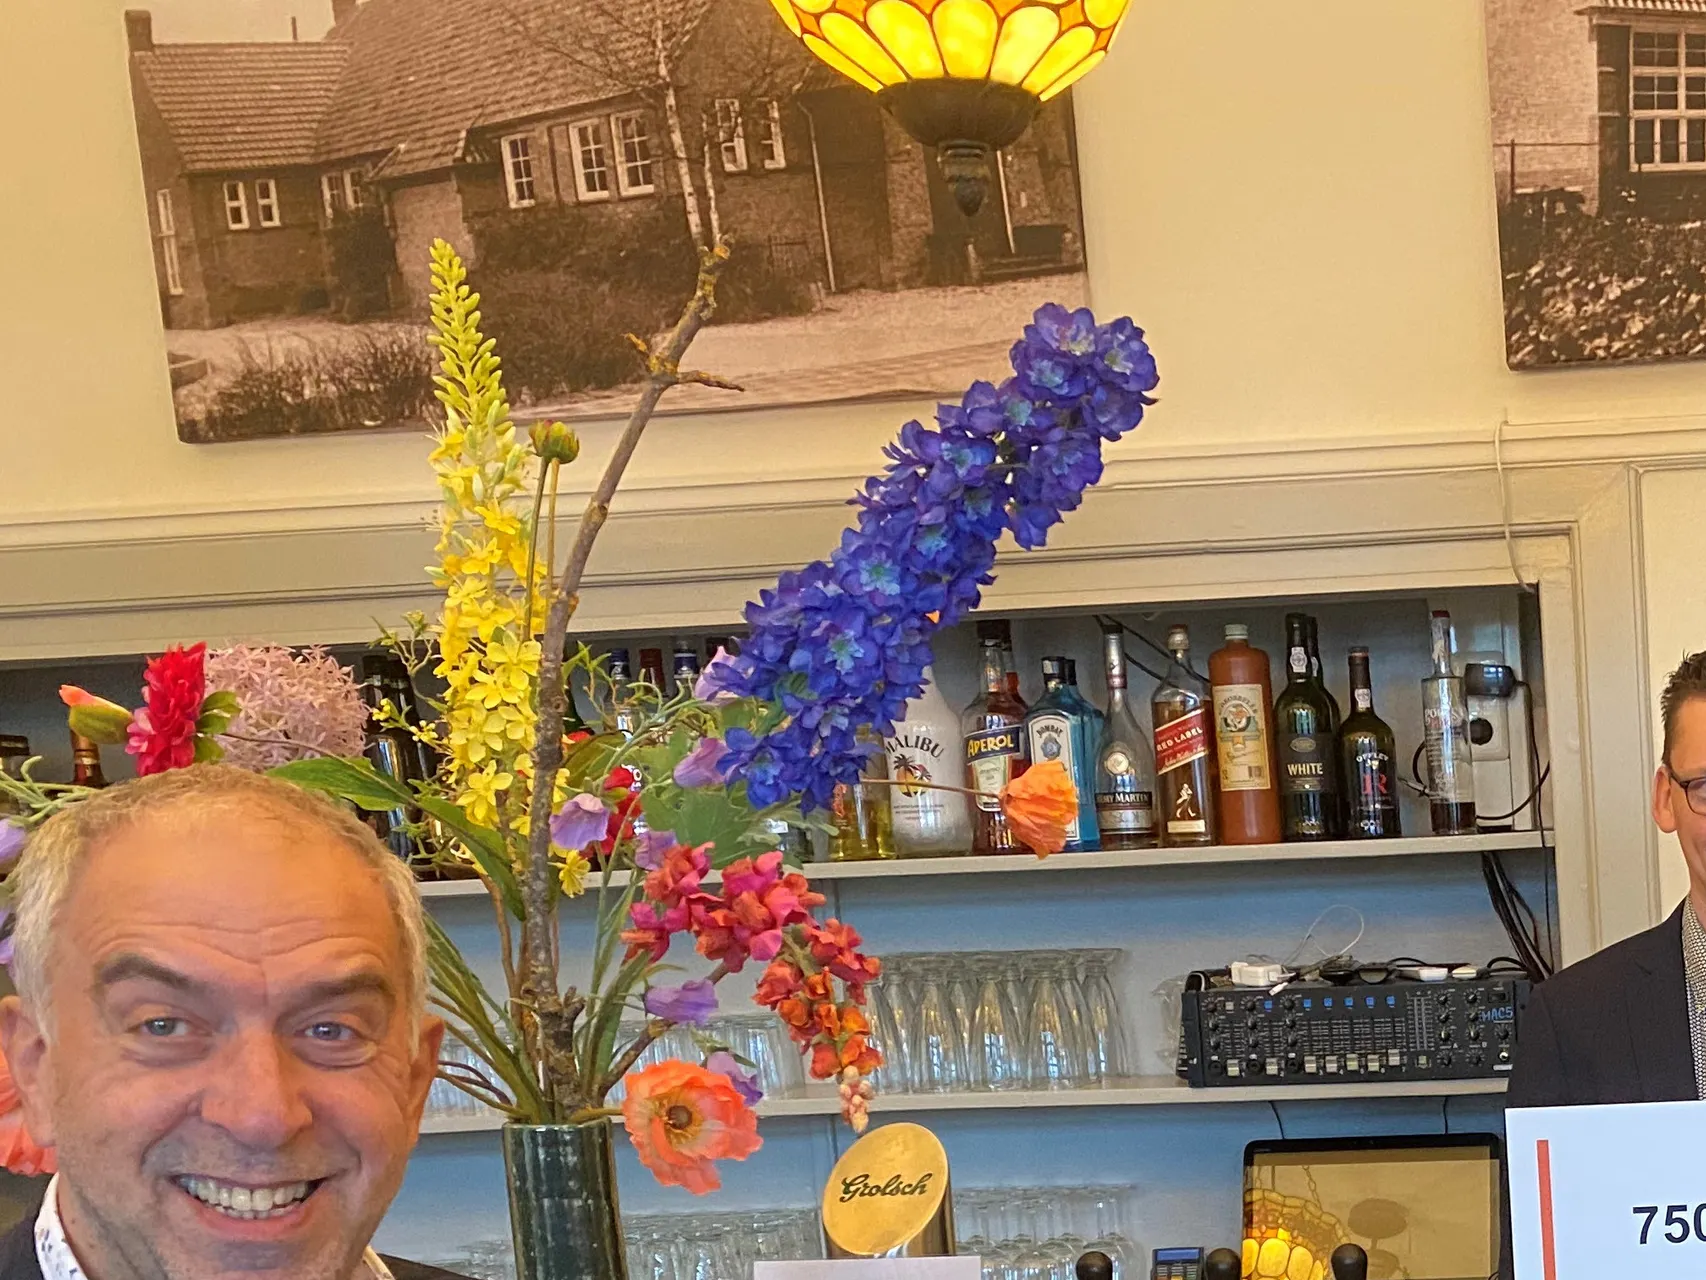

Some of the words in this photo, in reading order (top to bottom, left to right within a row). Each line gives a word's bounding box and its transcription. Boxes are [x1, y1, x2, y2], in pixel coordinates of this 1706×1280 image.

[967, 734, 1014, 758] APEROL
[1156, 738, 1174, 752] RED
[1175, 726, 1203, 743] LABEL
[1287, 762, 1324, 776] WHITE
[839, 1172, 933, 1203] Grolsch
